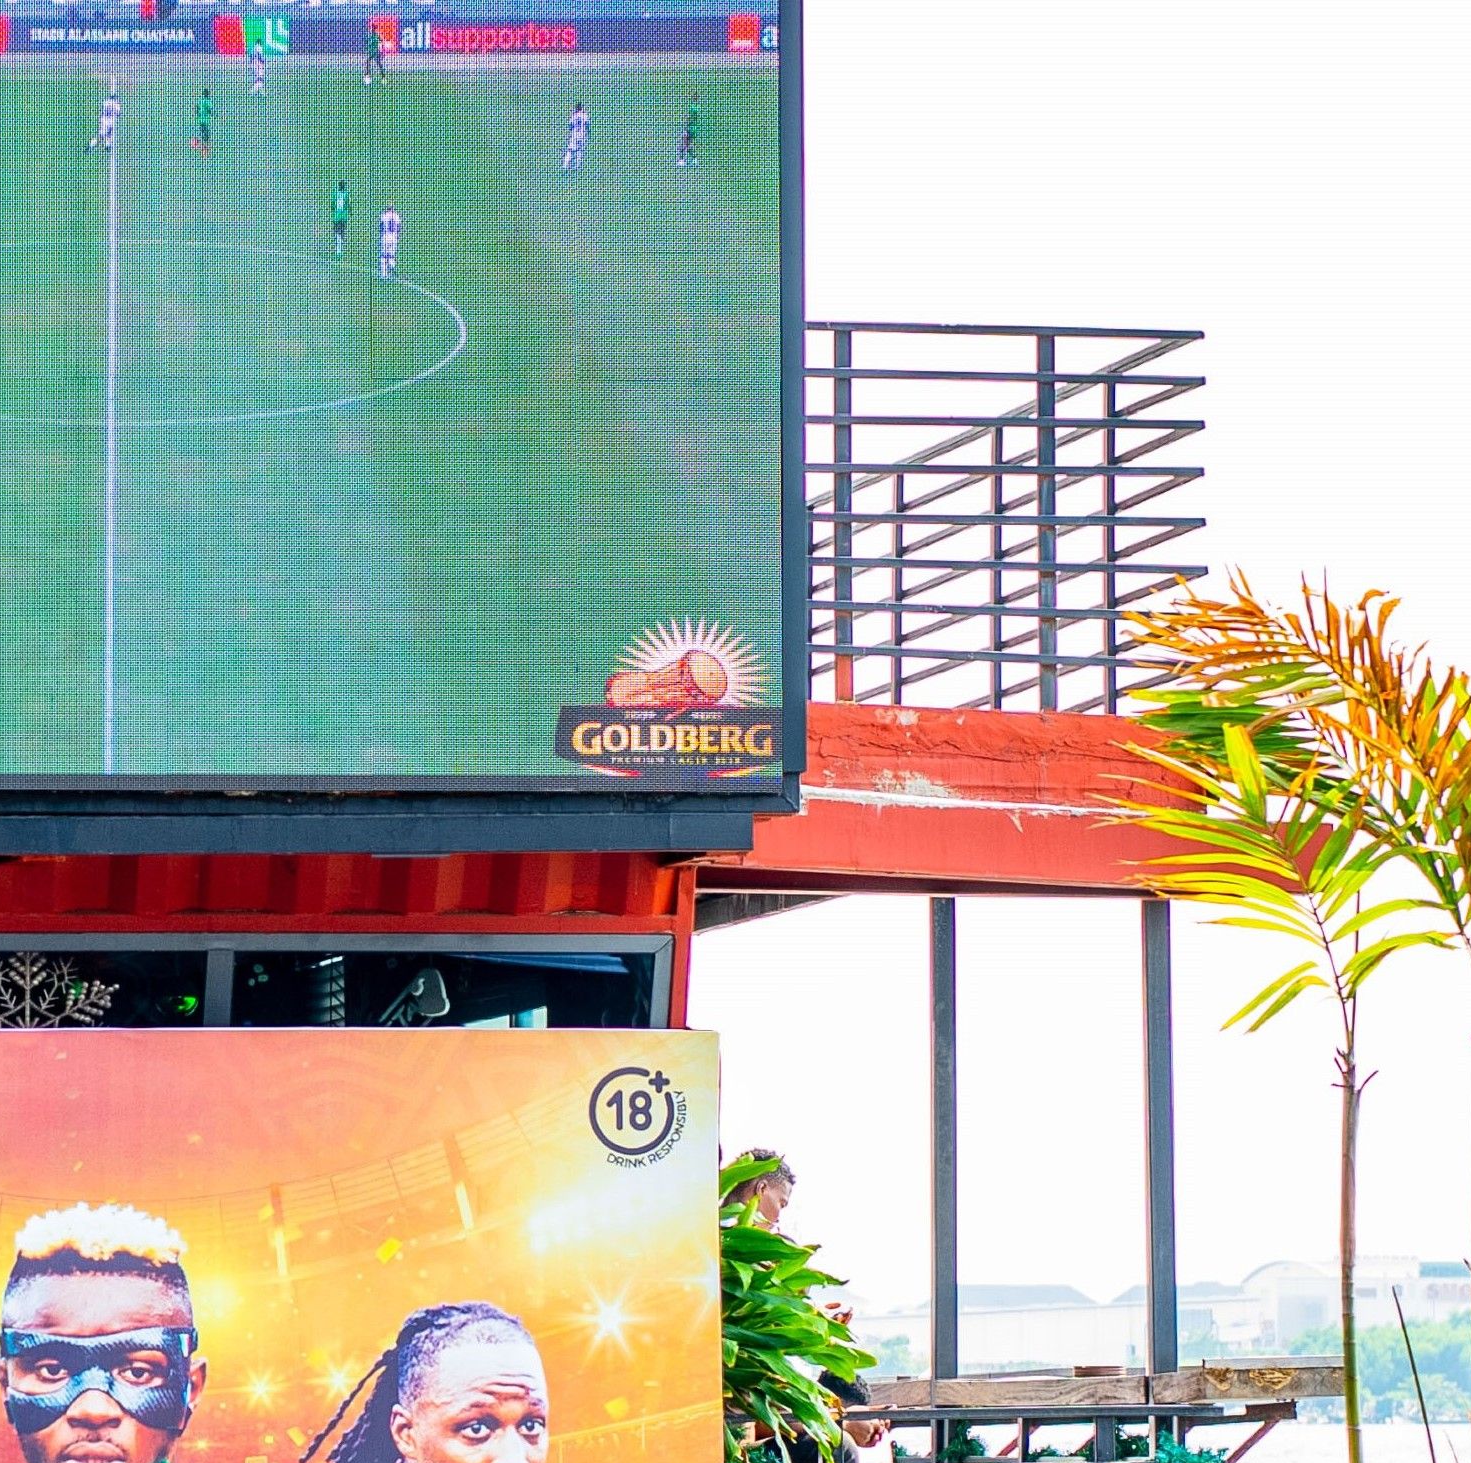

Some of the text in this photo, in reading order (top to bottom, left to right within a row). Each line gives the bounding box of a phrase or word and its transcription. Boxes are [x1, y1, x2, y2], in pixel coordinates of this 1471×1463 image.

[571, 720, 774, 757] GOLDBERG
[606, 1070, 670, 1131] 18+
[607, 1090, 687, 1169] DRINK RESPONSIBLY
